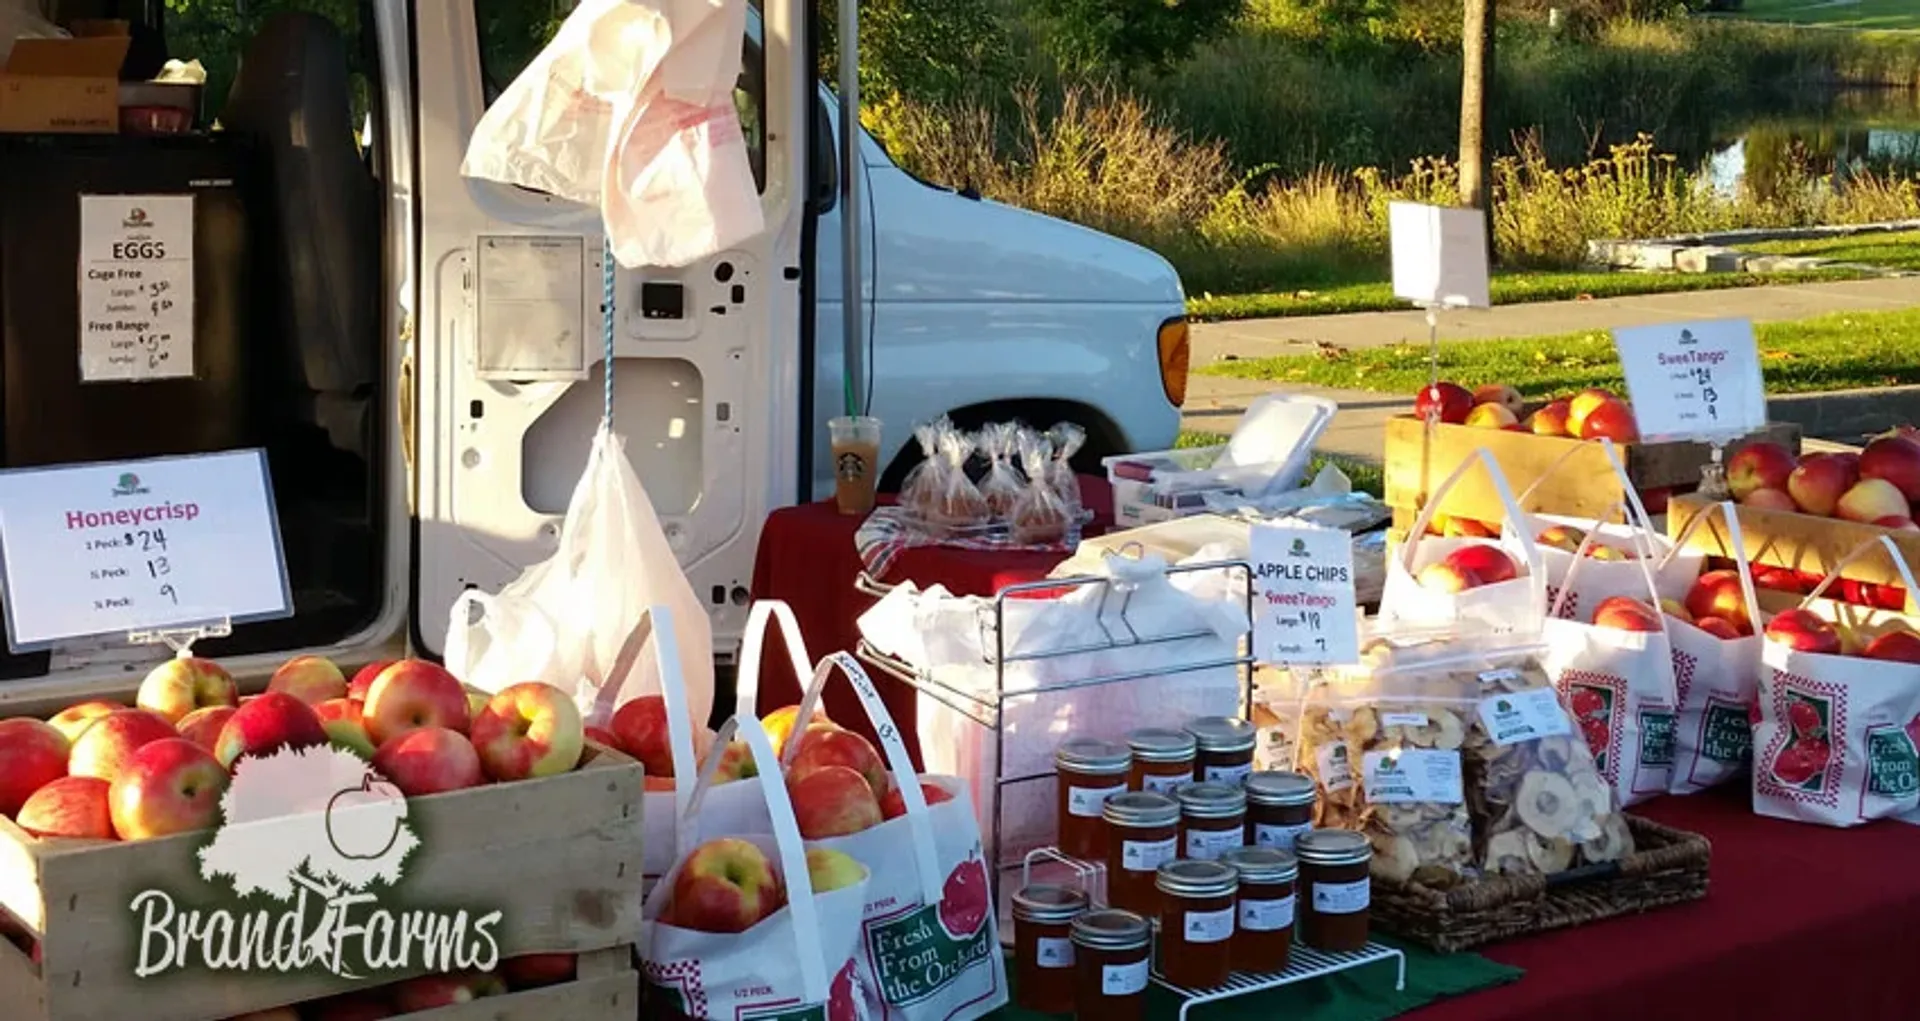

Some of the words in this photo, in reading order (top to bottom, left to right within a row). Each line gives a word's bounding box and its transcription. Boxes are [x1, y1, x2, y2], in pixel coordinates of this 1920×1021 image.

[112, 241, 165, 259] EGGS
[88, 268, 115, 281] Cage
[117, 267, 142, 279] Free
[88, 321, 113, 332] Free
[115, 320, 150, 333] Range
[1708, 404, 1718, 420] 9
[65, 501, 199, 529] Honeycrisp
[95, 537, 123, 549] Peck:
[101, 566, 130, 579] Peck:
[147, 556, 170, 578] 13
[1257, 563, 1303, 580] APPLE
[1305, 565, 1349, 582] CHIPS
[105, 596, 134, 608] Peck:
[160, 582, 177, 605] 9
[1265, 589, 1337, 609] SweeTango
[876, 919, 934, 953] Fresh
[880, 946, 938, 978] From
[887, 976, 921, 1001] the
[925, 932, 987, 987] Orchard
